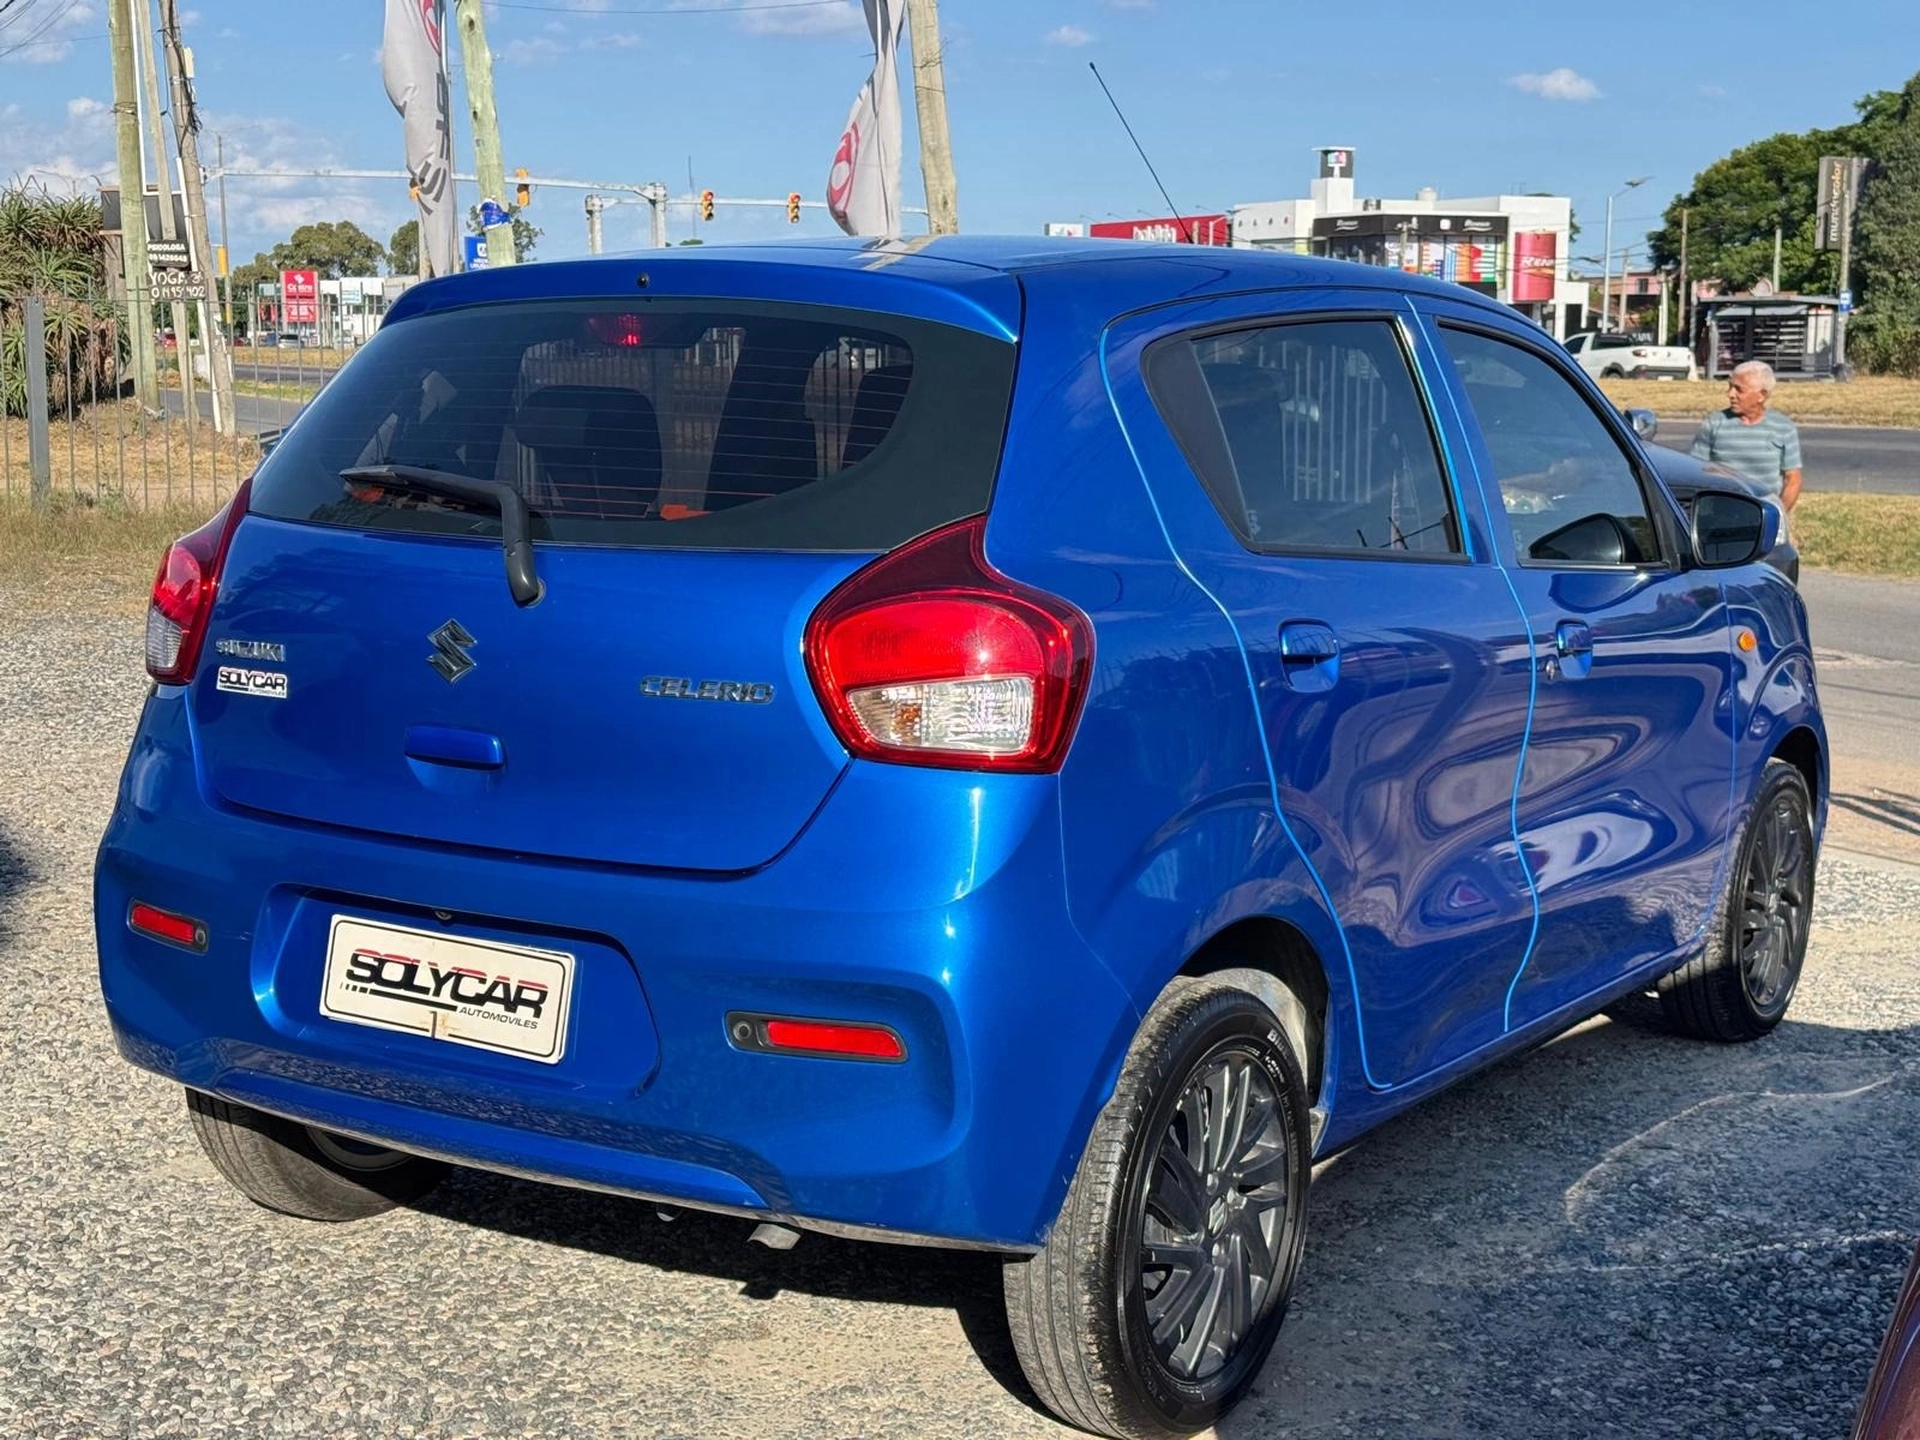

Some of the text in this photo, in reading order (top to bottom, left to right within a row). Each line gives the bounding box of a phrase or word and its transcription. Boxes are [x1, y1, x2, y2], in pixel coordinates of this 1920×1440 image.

[150, 271, 187, 286] YOGA
[215, 639, 286, 662] SUZUKI
[219, 667, 286, 690] SOLYCAR
[640, 676, 774, 704] CELERIO
[346, 948, 549, 1019] SOLYCAR
[459, 1006, 538, 1029] AUTOMOVILES
